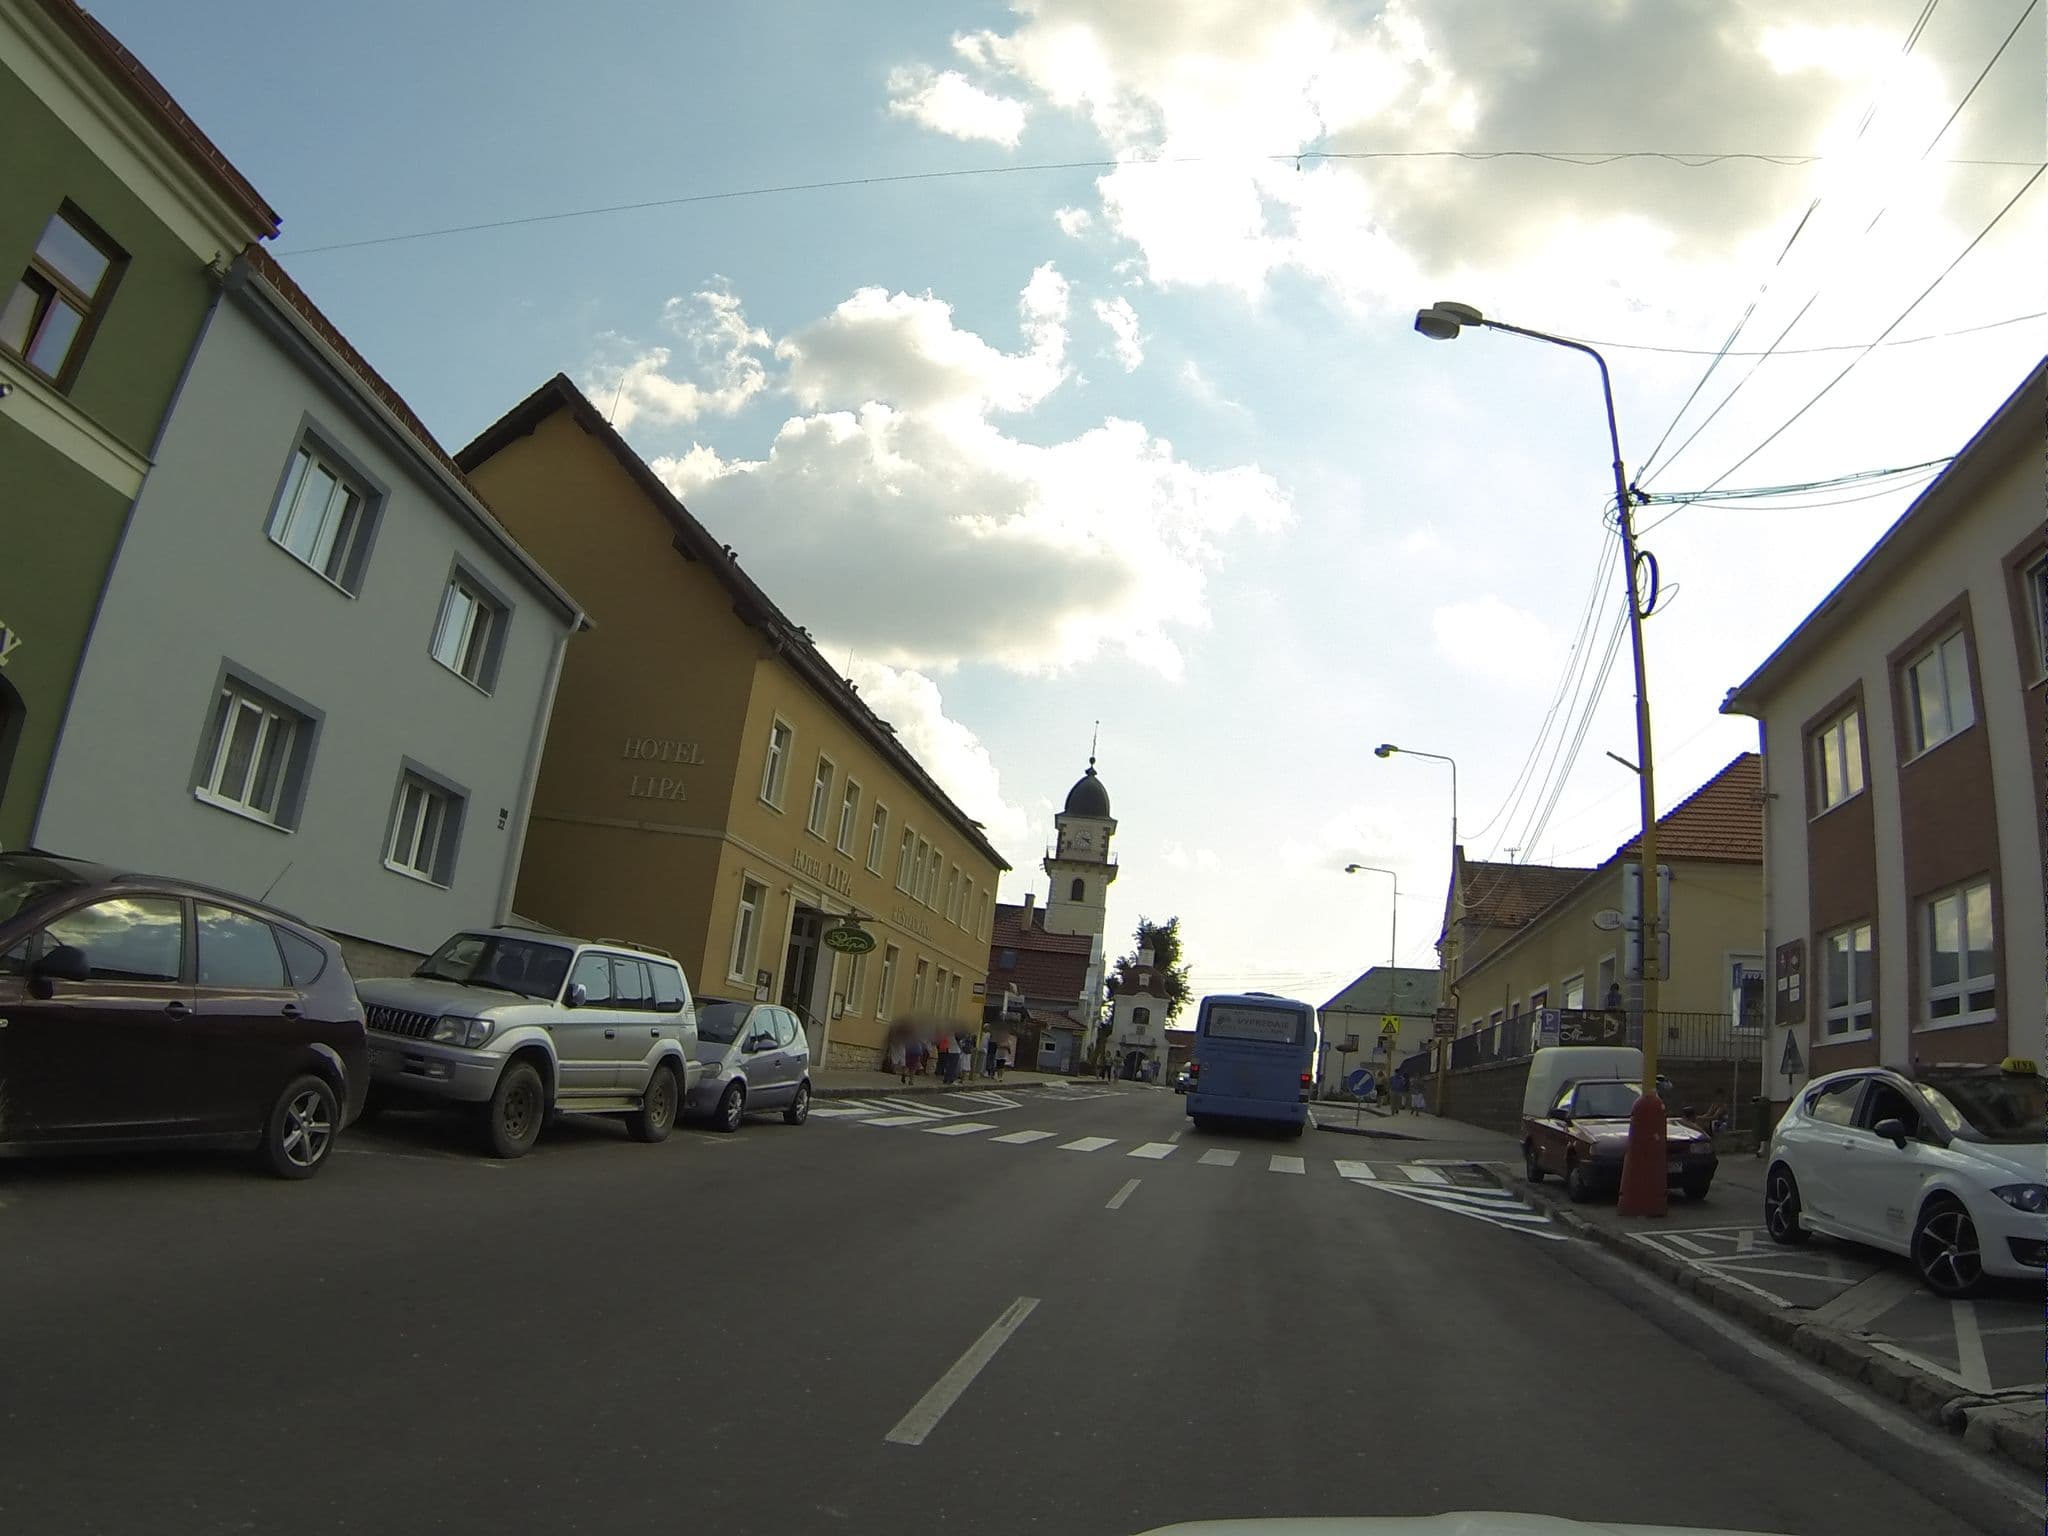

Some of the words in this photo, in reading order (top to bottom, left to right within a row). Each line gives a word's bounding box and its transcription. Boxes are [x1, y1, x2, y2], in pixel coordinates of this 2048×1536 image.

[623, 738, 704, 765] HOTEL
[630, 776, 687, 800] LIPA
[794, 848, 824, 880] HOTEL
[827, 864, 852, 897] LIPA
[1545, 1013, 1554, 1026] P
